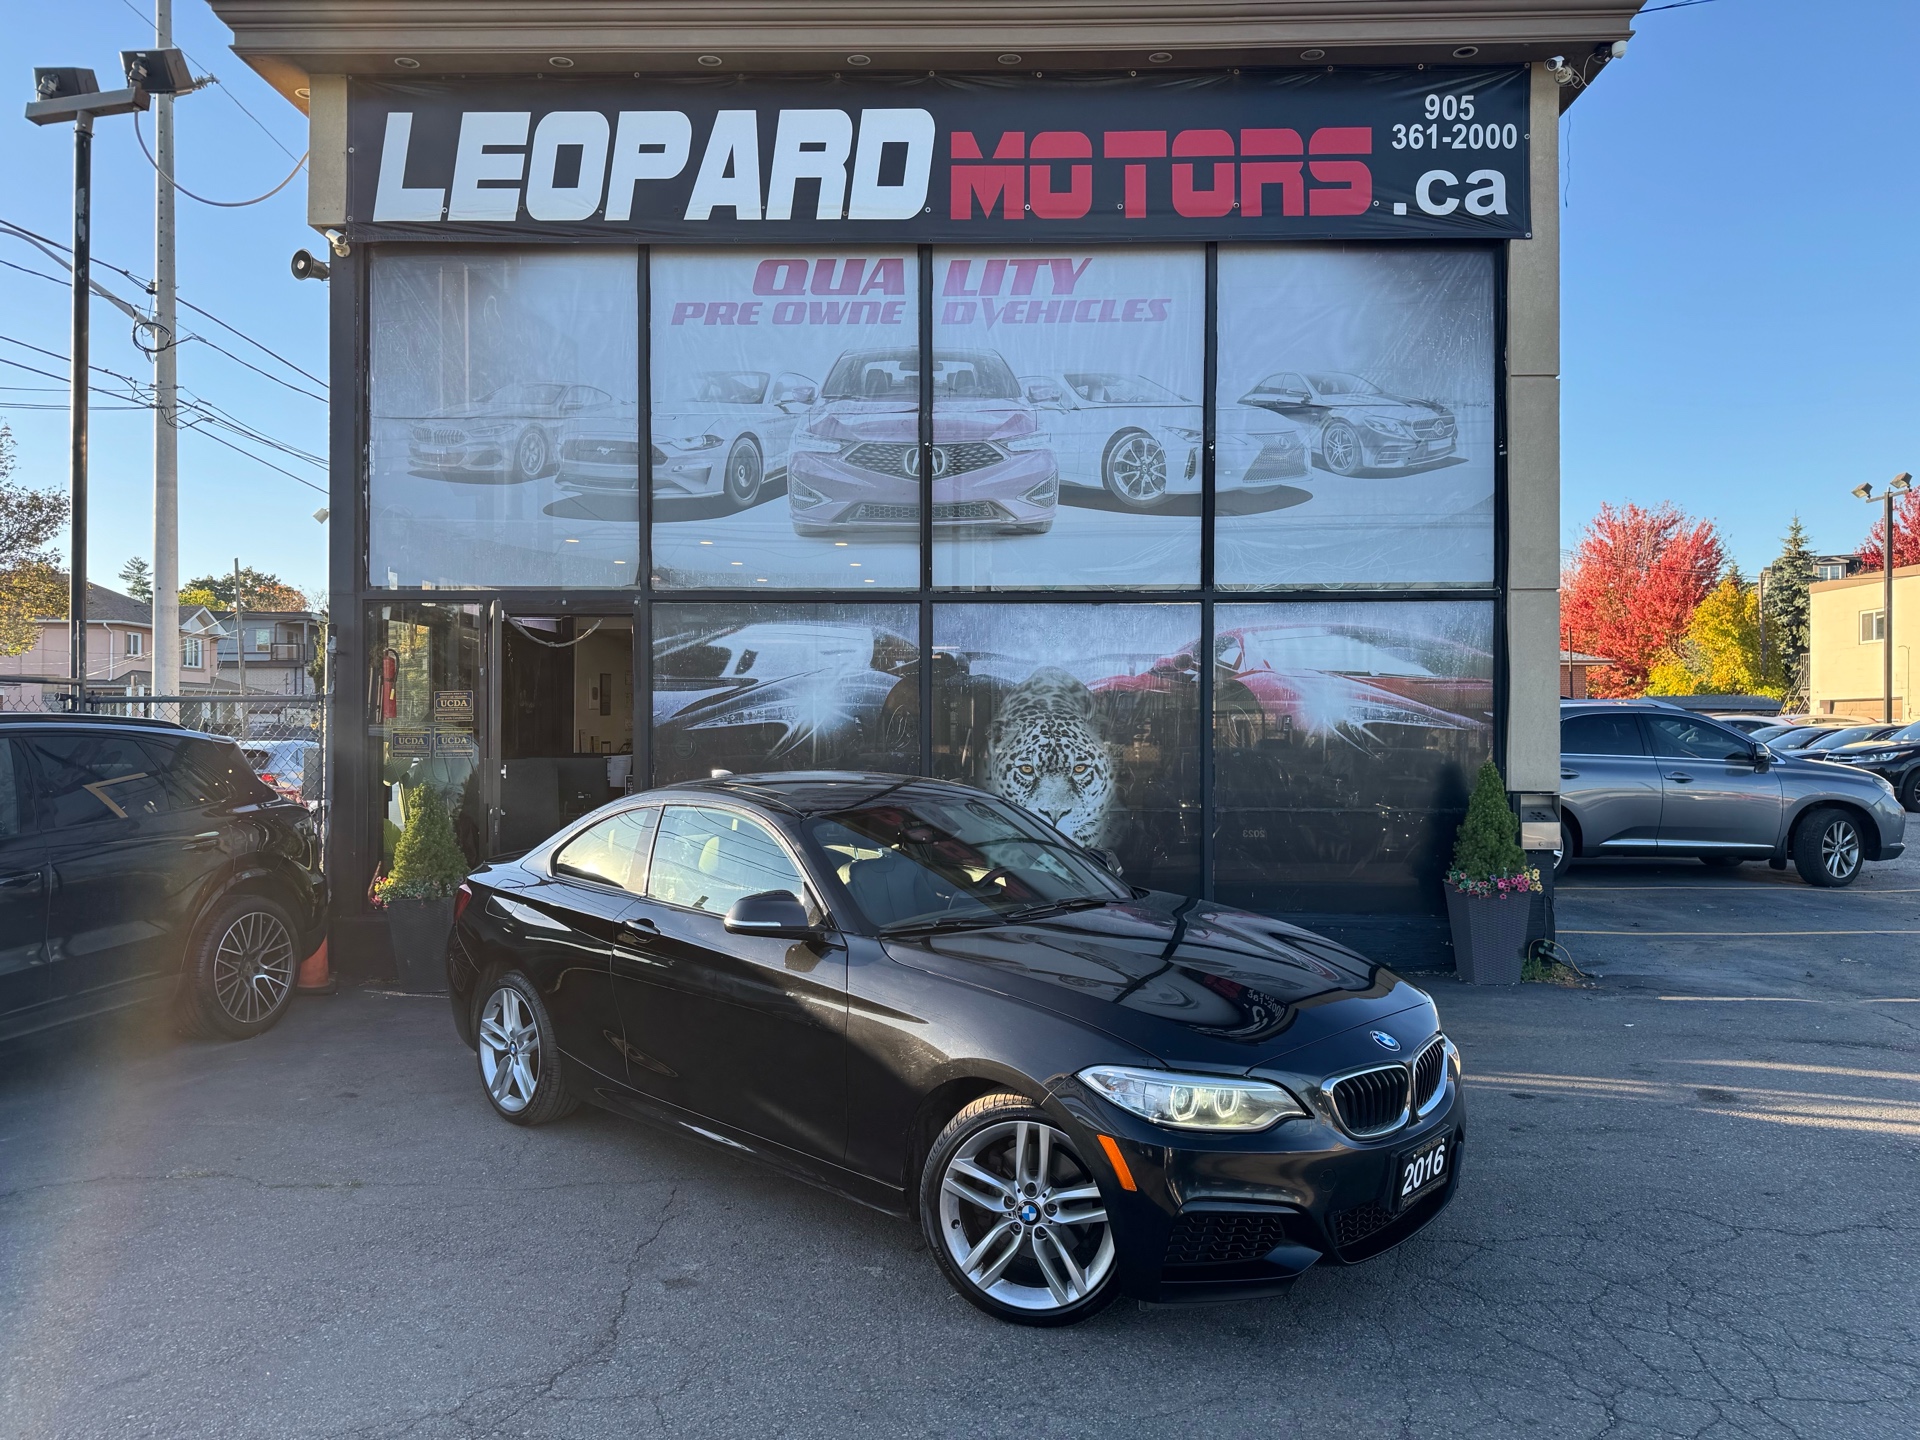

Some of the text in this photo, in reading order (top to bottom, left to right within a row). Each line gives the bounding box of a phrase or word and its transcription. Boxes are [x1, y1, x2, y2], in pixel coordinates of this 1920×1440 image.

[1424, 94, 1475, 121] 905
[1392, 124, 1518, 150] 361-2000
[372, 108, 1372, 222] LEOPARD MOTORS
[1393, 167, 1509, 217] .ca
[671, 301, 764, 326] PRE
[440, 699, 468, 707] UCDA
[398, 737, 424, 745] UCDA
[1401, 1144, 1445, 1196] 2016
